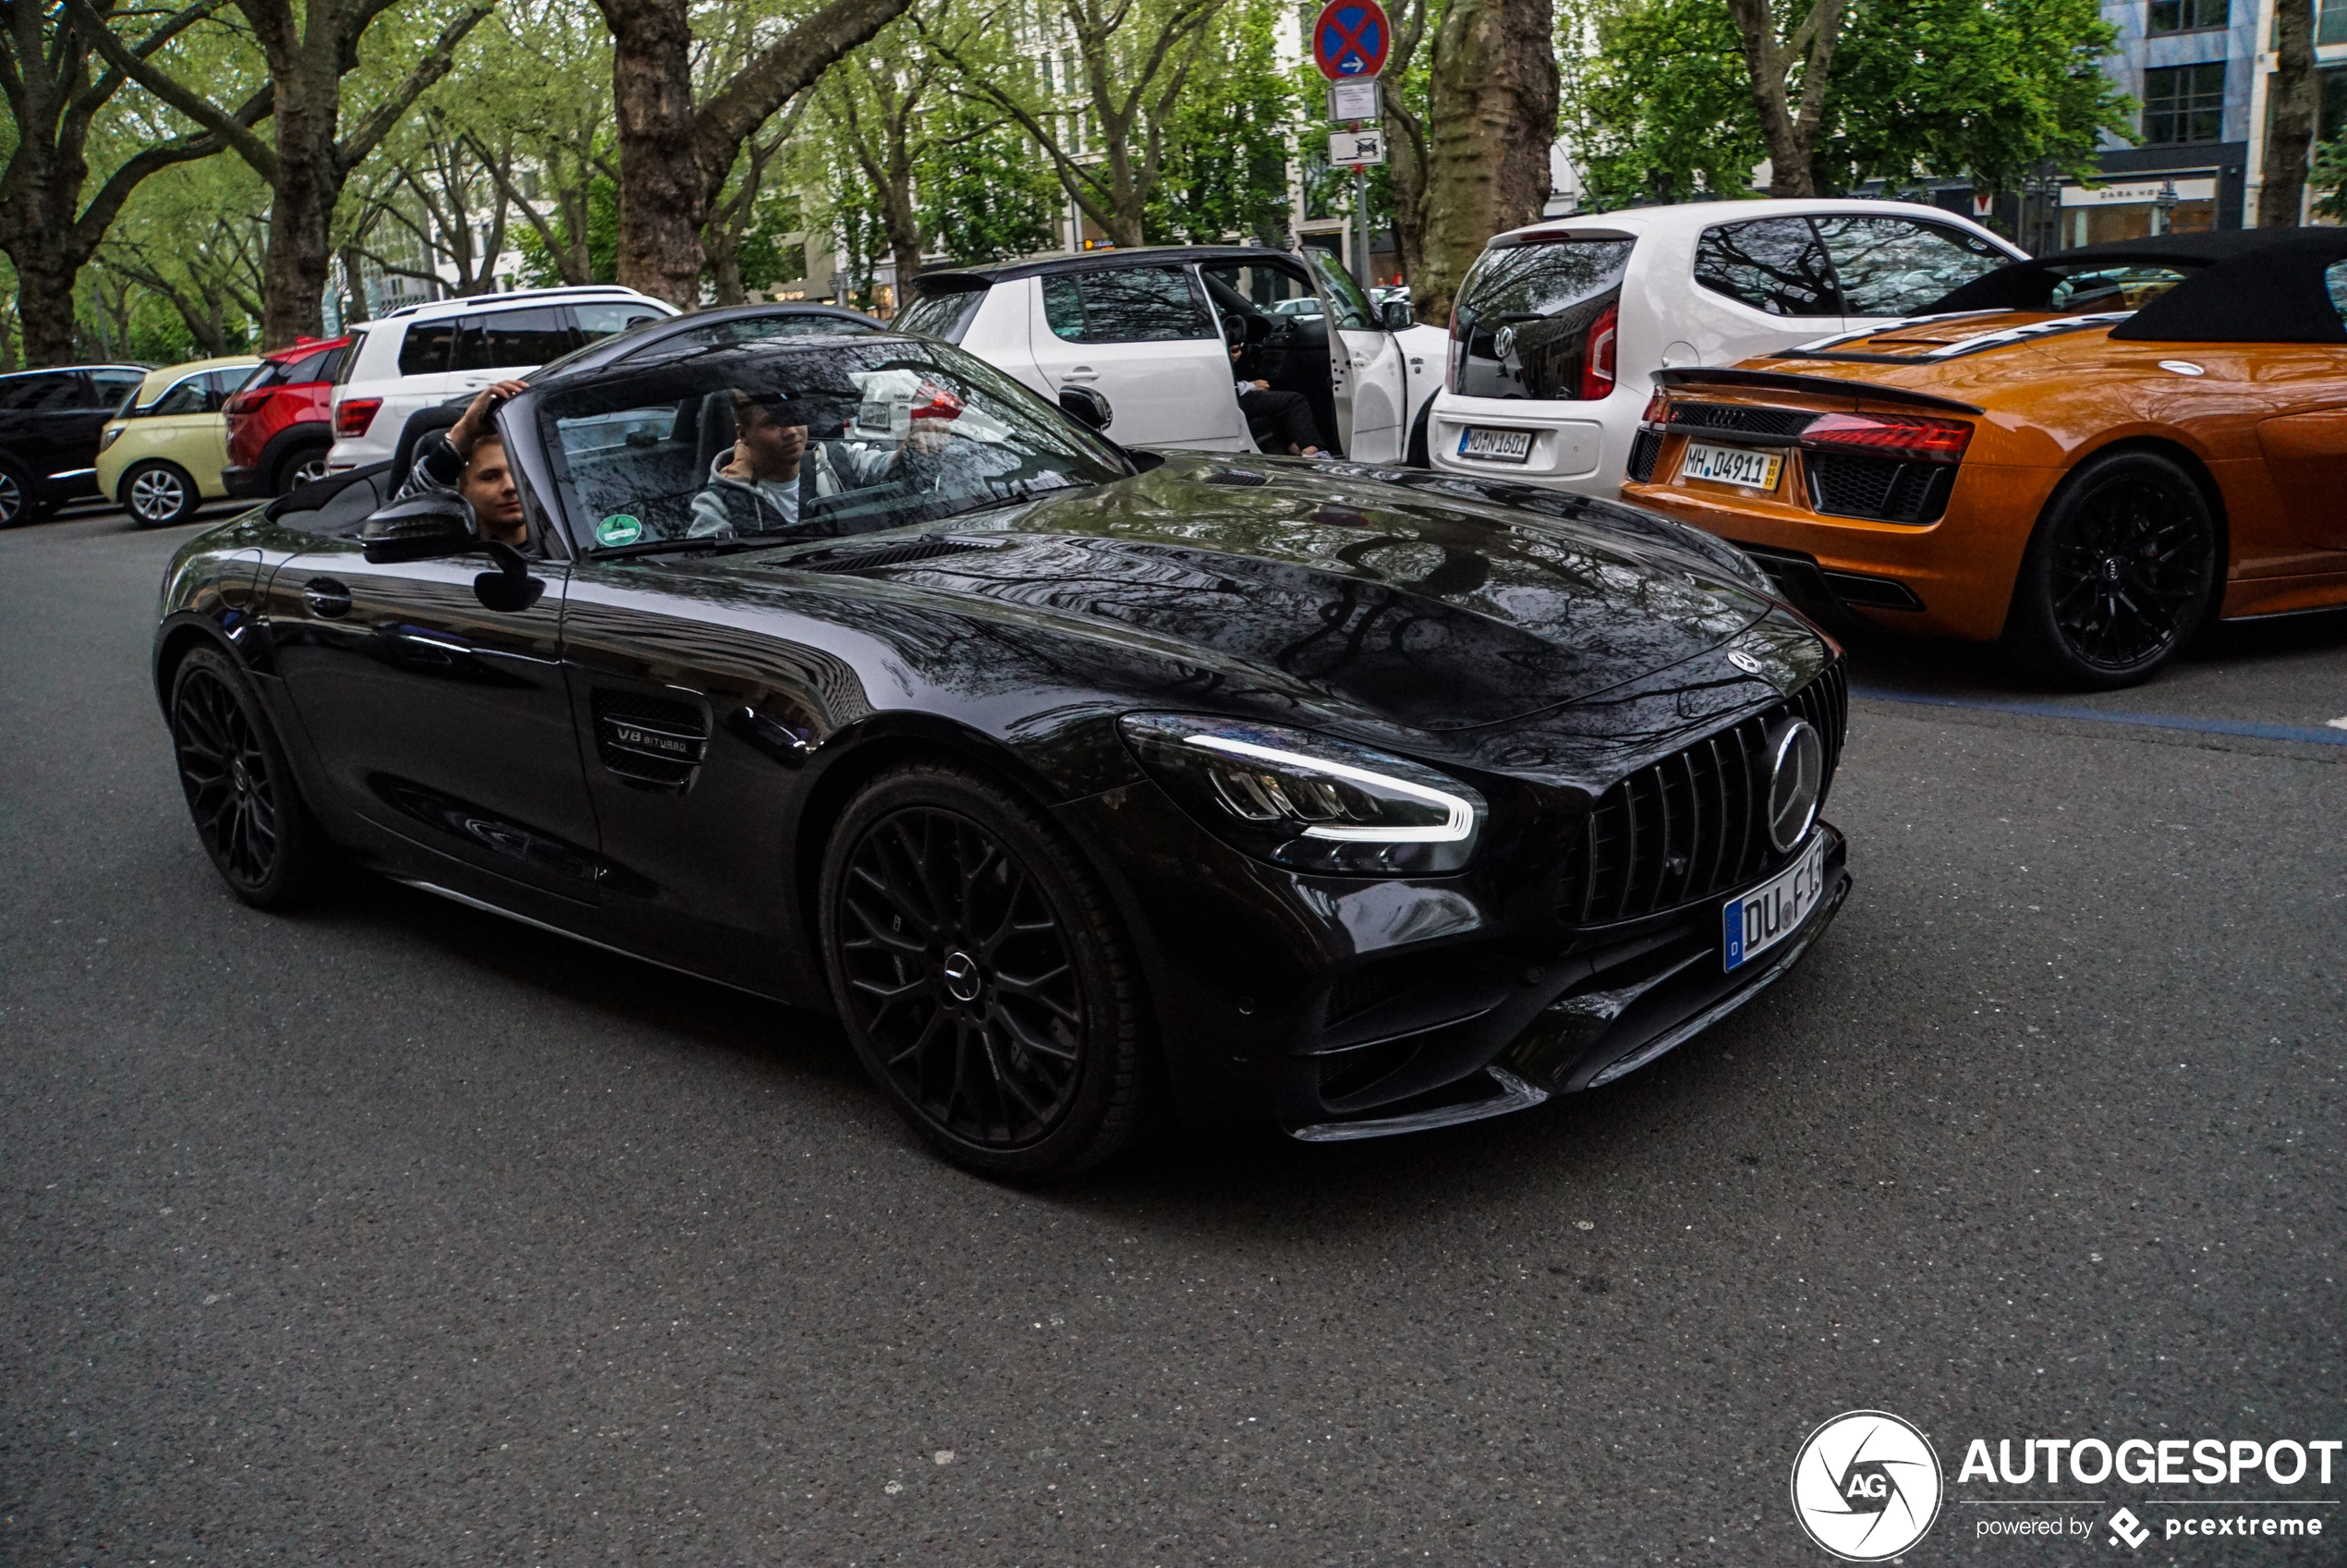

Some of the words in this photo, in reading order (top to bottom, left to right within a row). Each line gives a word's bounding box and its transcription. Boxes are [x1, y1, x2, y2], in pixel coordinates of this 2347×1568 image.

[1684, 447, 1708, 474] MH
[612, 517, 625, 529] 4
[616, 727, 642, 743] V8
[1744, 886, 1781, 953] DU
[1731, 941, 1739, 956] D
